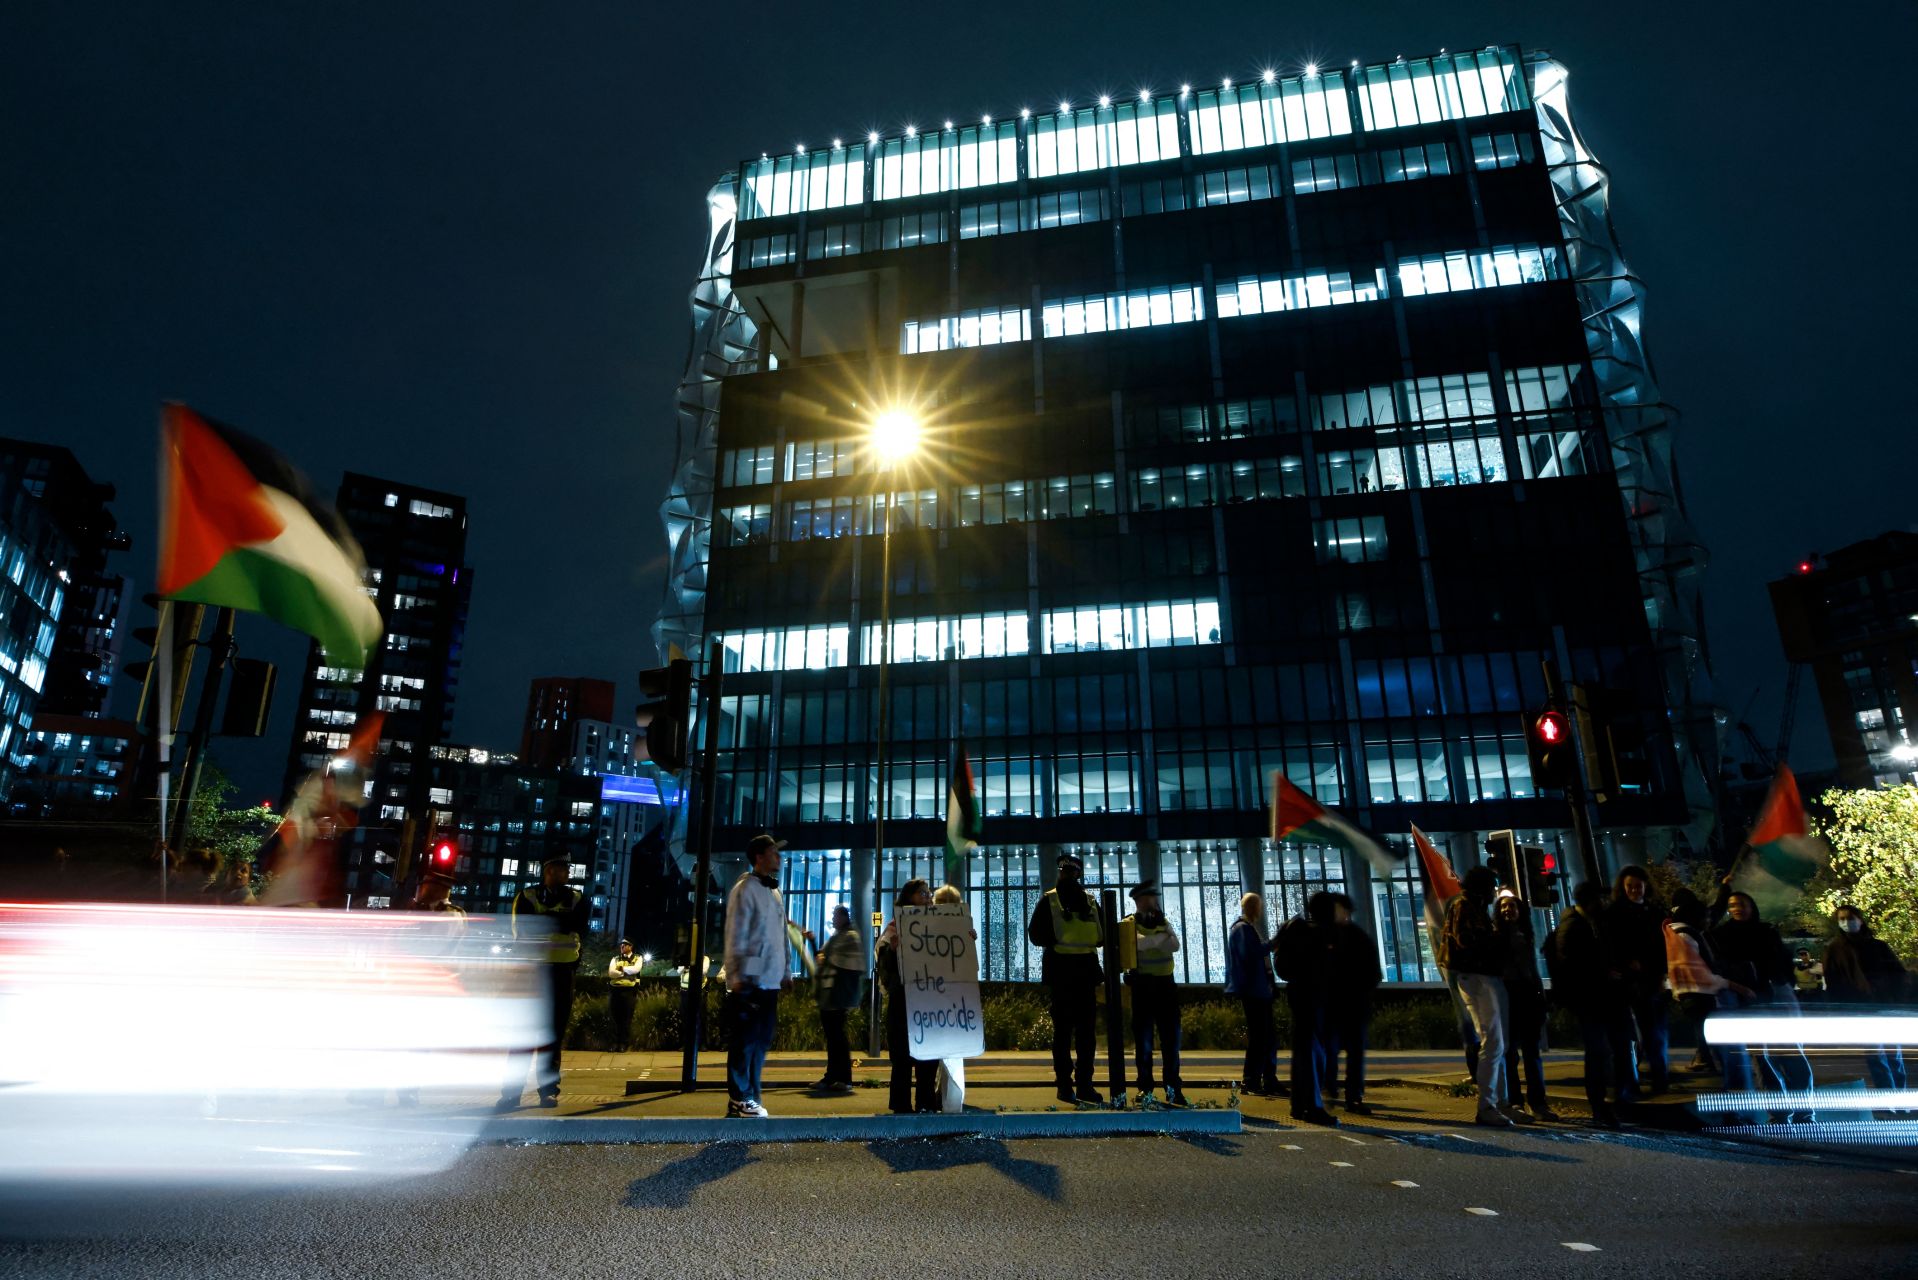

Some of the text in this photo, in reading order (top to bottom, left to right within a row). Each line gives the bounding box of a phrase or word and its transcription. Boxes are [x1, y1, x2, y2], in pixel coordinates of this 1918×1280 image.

[909, 921, 966, 973] Stop
[913, 964, 945, 994] the
[913, 996, 977, 1044] genocide
